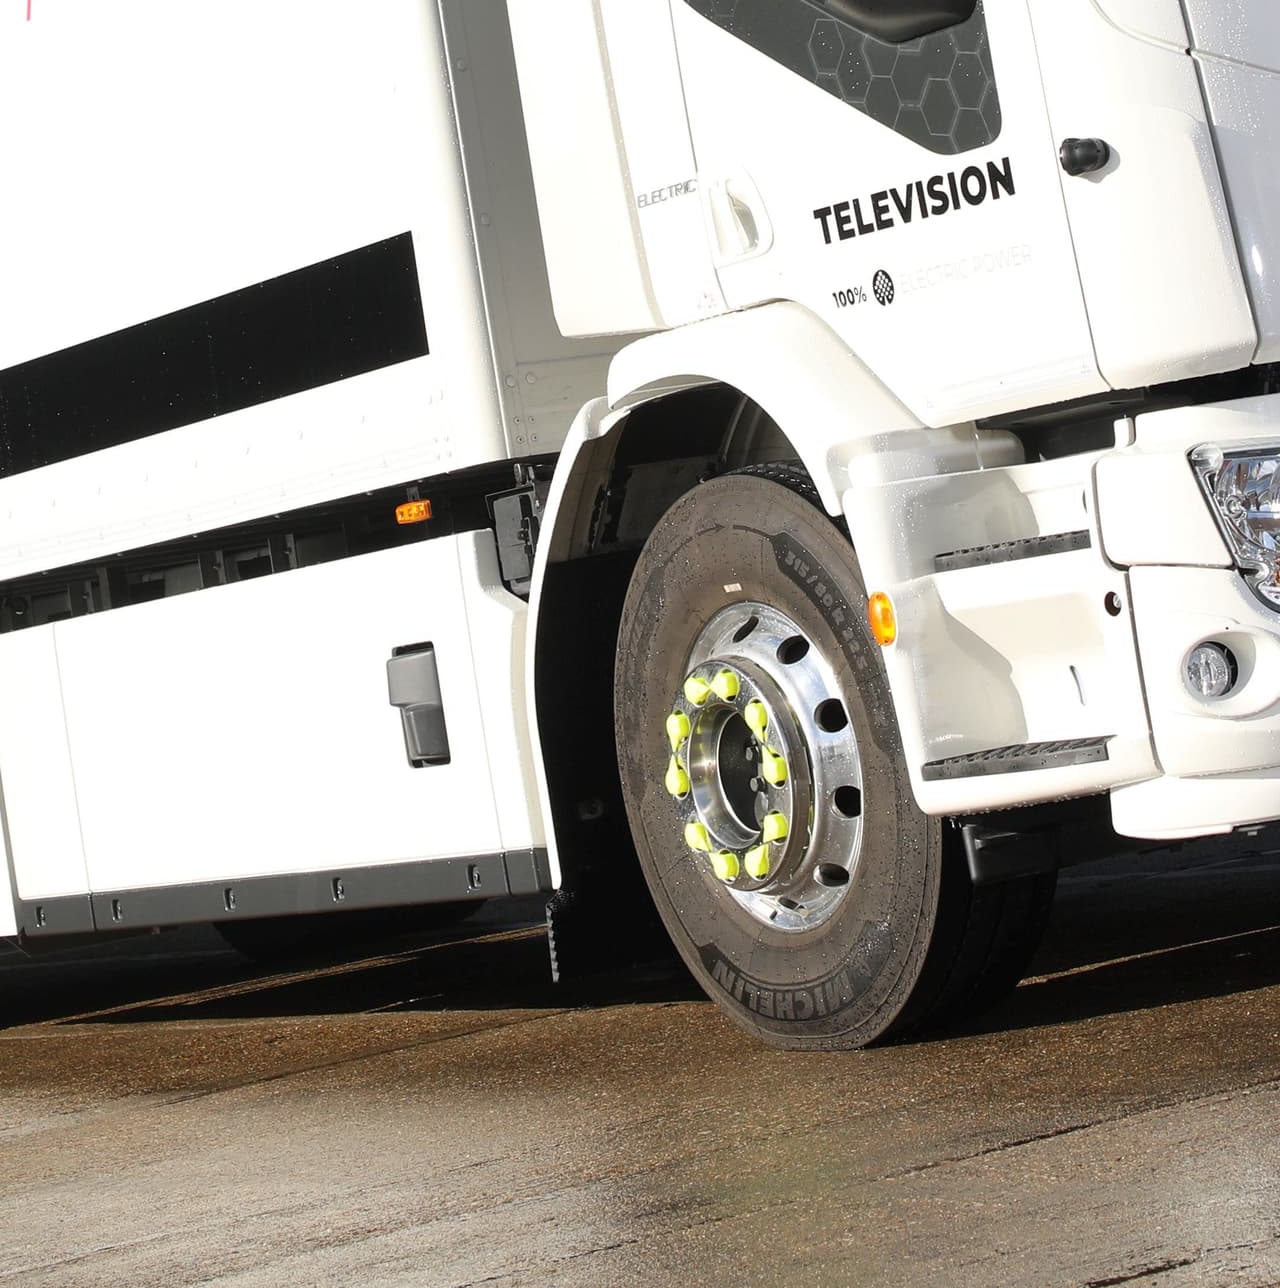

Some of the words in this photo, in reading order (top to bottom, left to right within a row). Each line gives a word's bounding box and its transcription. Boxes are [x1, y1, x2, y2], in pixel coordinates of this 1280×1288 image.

[637, 179, 698, 209] ELECTRIC
[813, 157, 1016, 245] TELEVISION
[832, 285, 868, 309] 100%
[900, 258, 969, 295] ELECTRIC
[971, 244, 1033, 274] POWER
[711, 961, 855, 1020] MICHELIN
